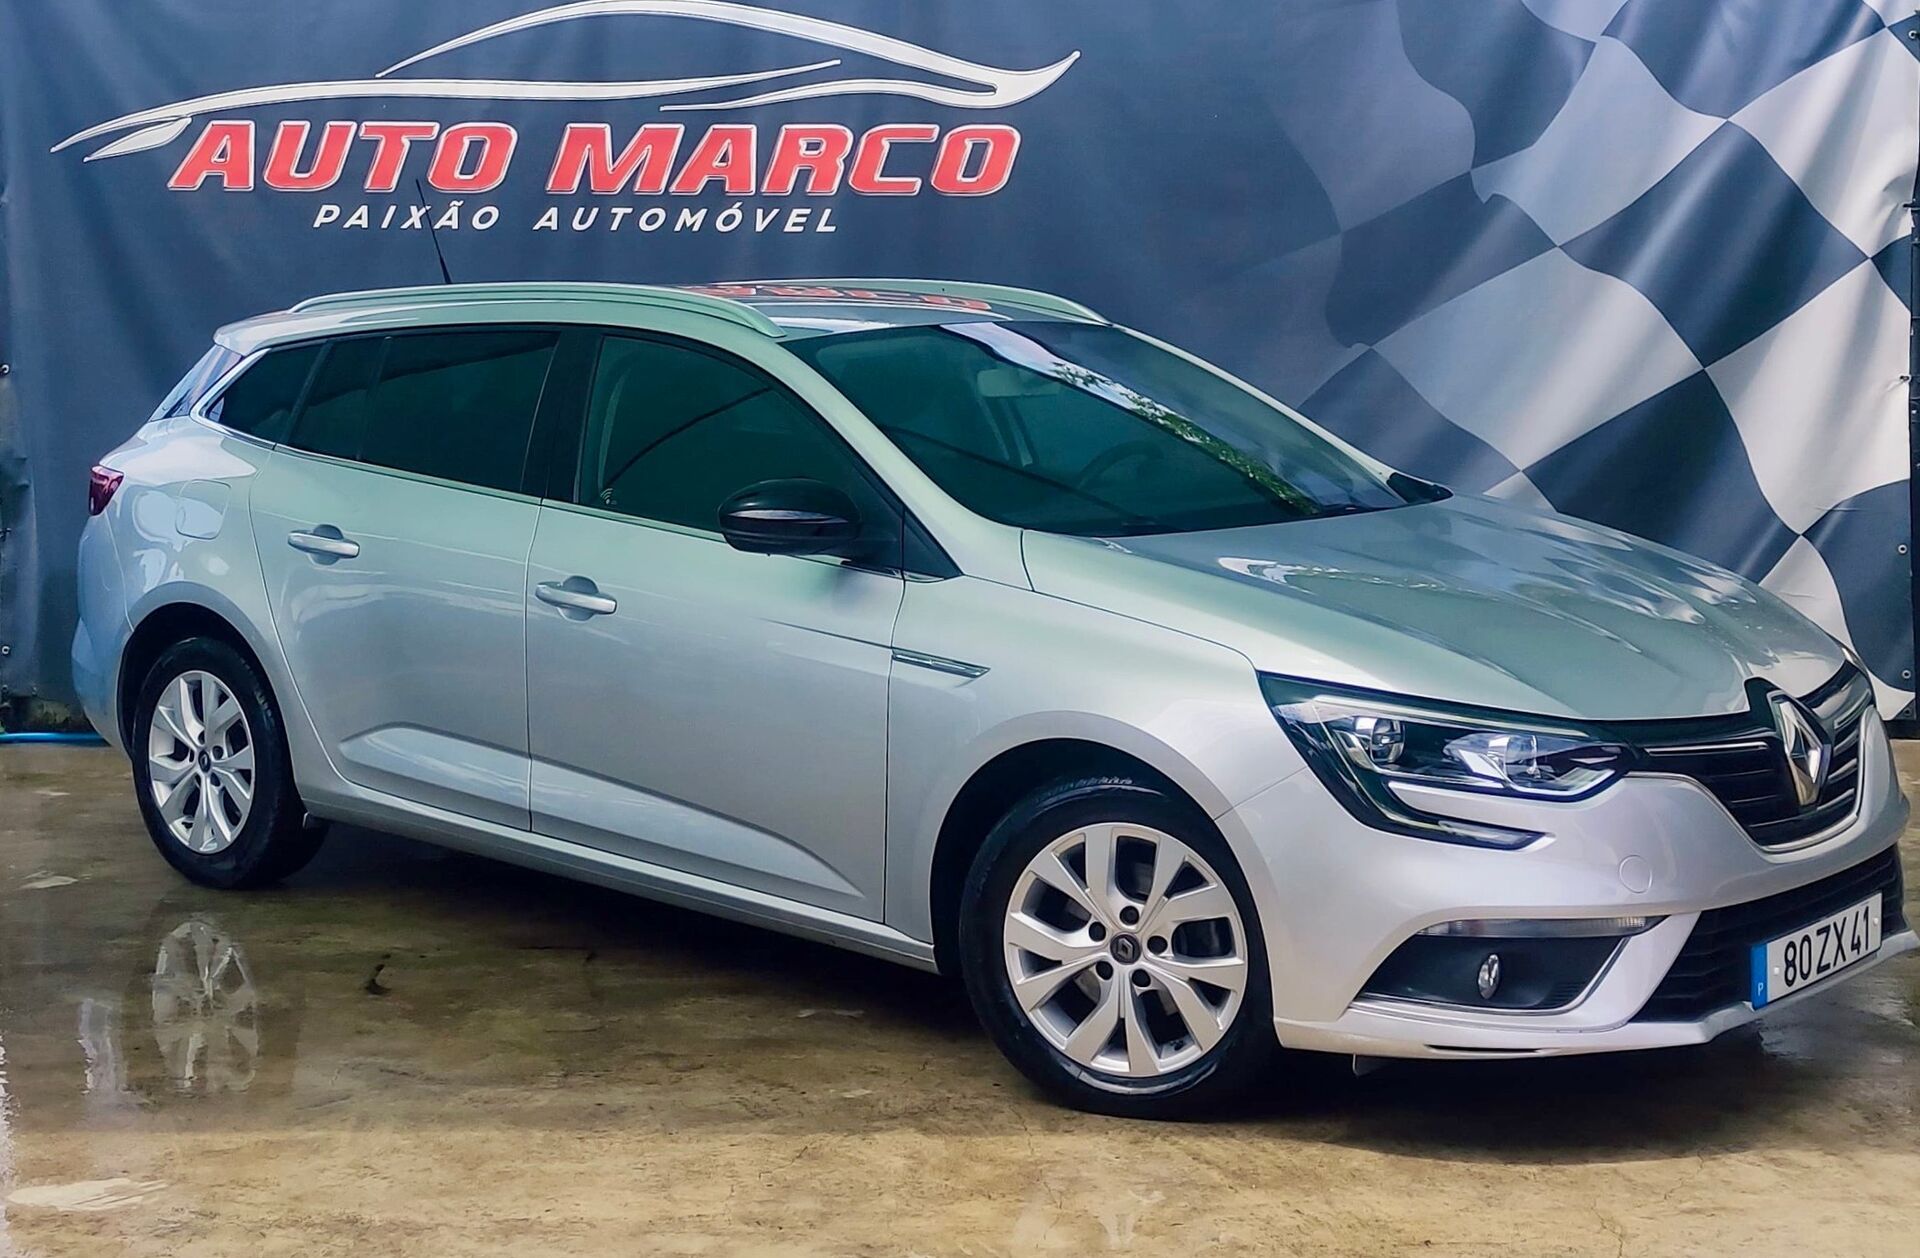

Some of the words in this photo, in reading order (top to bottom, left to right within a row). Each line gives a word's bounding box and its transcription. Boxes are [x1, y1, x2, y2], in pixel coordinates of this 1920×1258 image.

[167, 119, 518, 193] AUTO
[545, 122, 1021, 196] MARCO
[312, 200, 500, 230] PAIXÃO
[532, 201, 837, 233] AUTOMÓVEL
[1757, 982, 1764, 997] P
